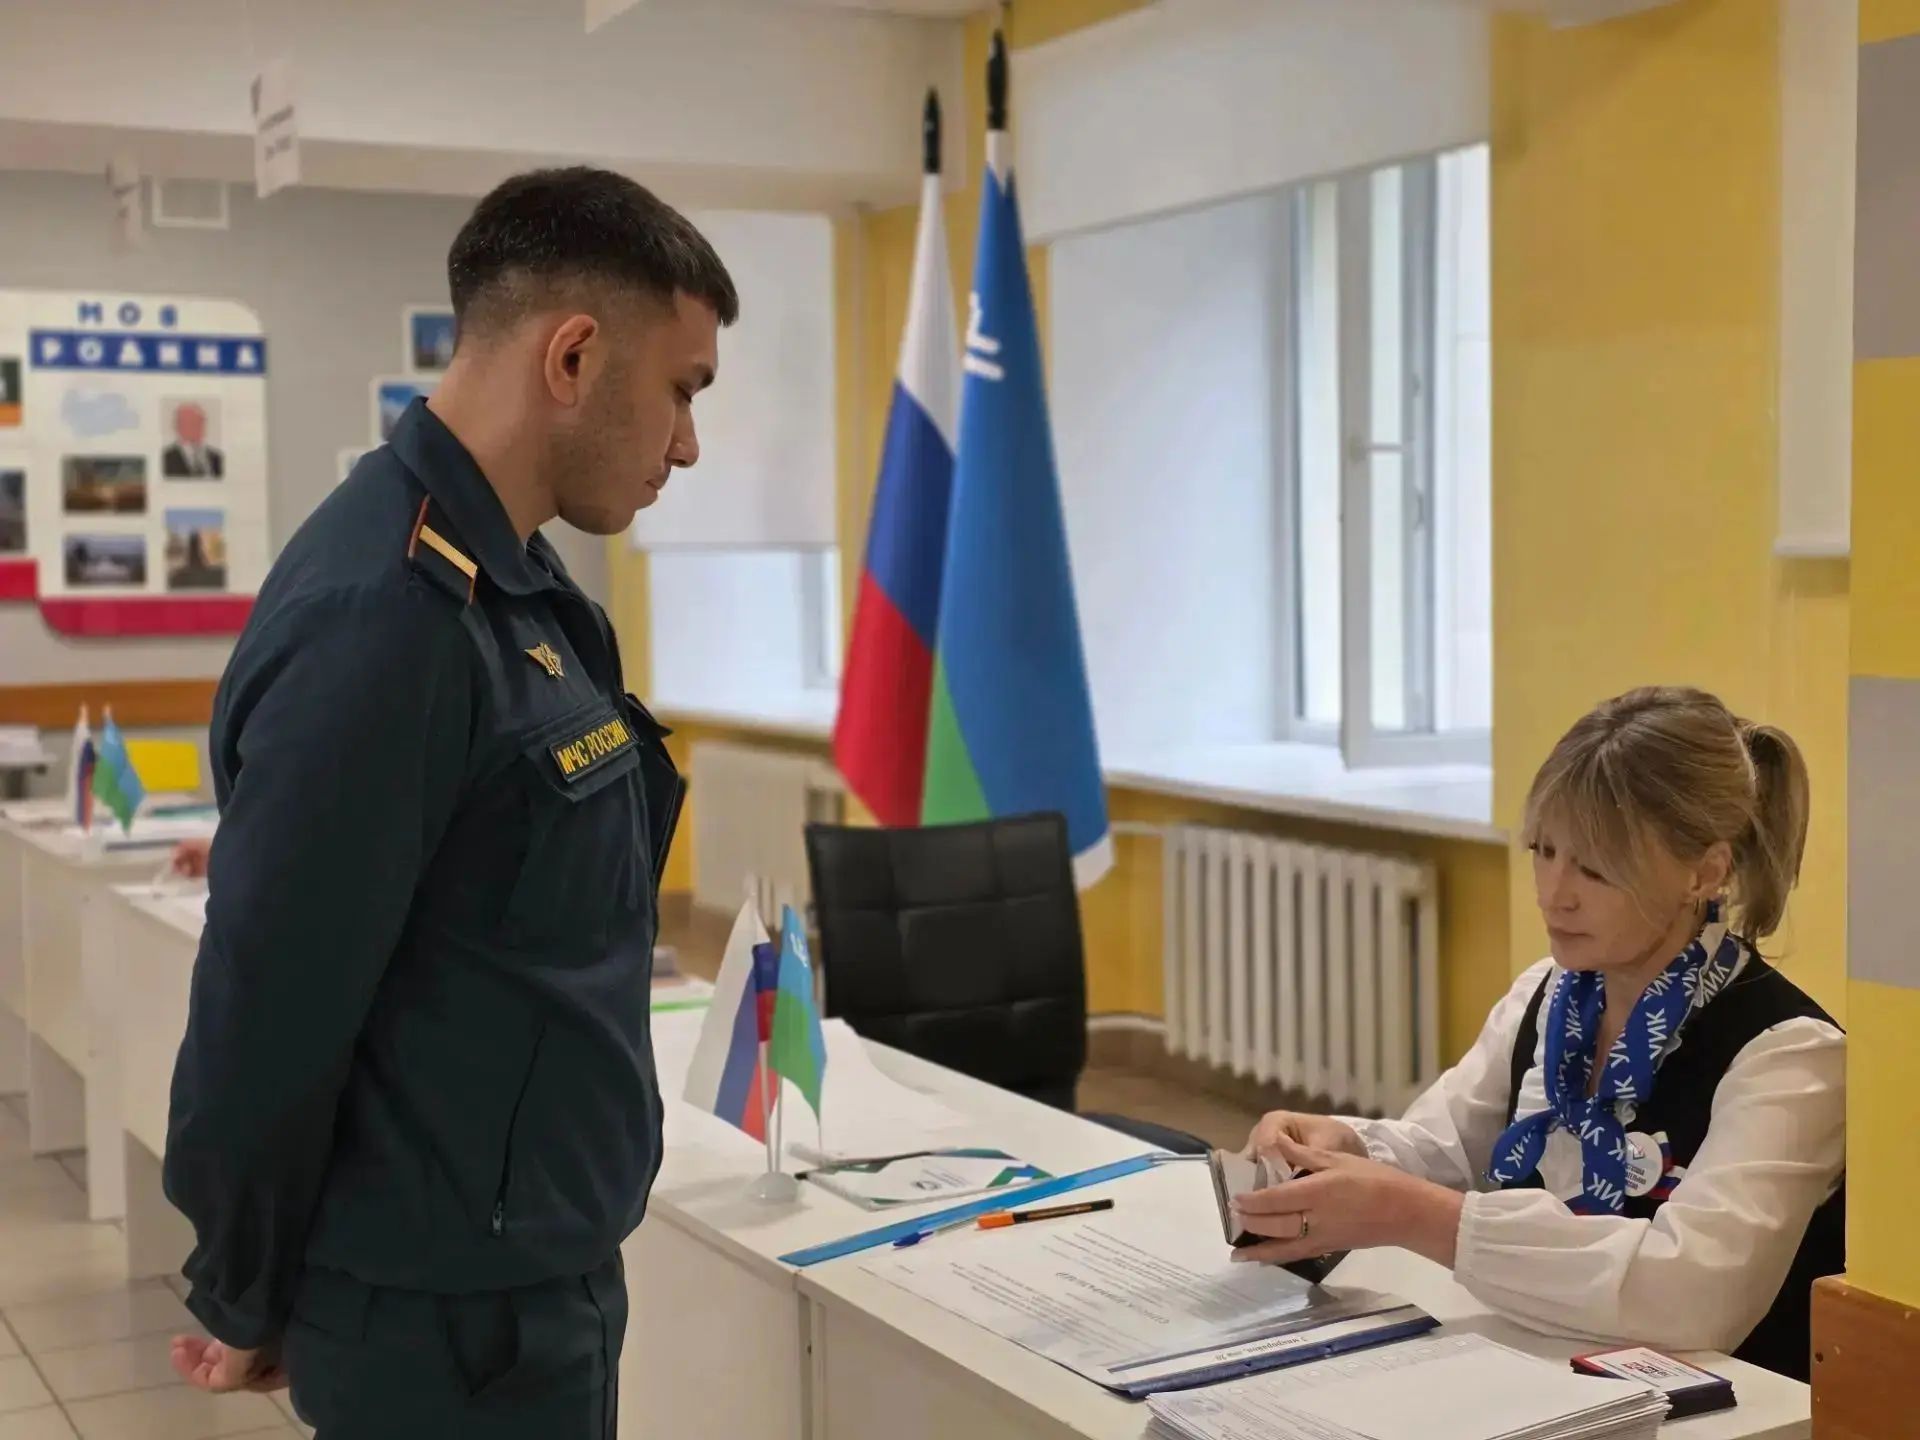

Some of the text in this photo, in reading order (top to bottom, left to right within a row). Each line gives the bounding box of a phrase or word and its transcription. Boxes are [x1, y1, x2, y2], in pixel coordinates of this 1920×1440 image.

[42, 338, 256, 368] РОДИНА
[557, 719, 629, 774] МЧС РОССИИ
[1610, 1027, 1630, 1068] УИ
[1646, 1007, 1668, 1060] УИК
[1587, 1172, 1625, 1211] ИК
